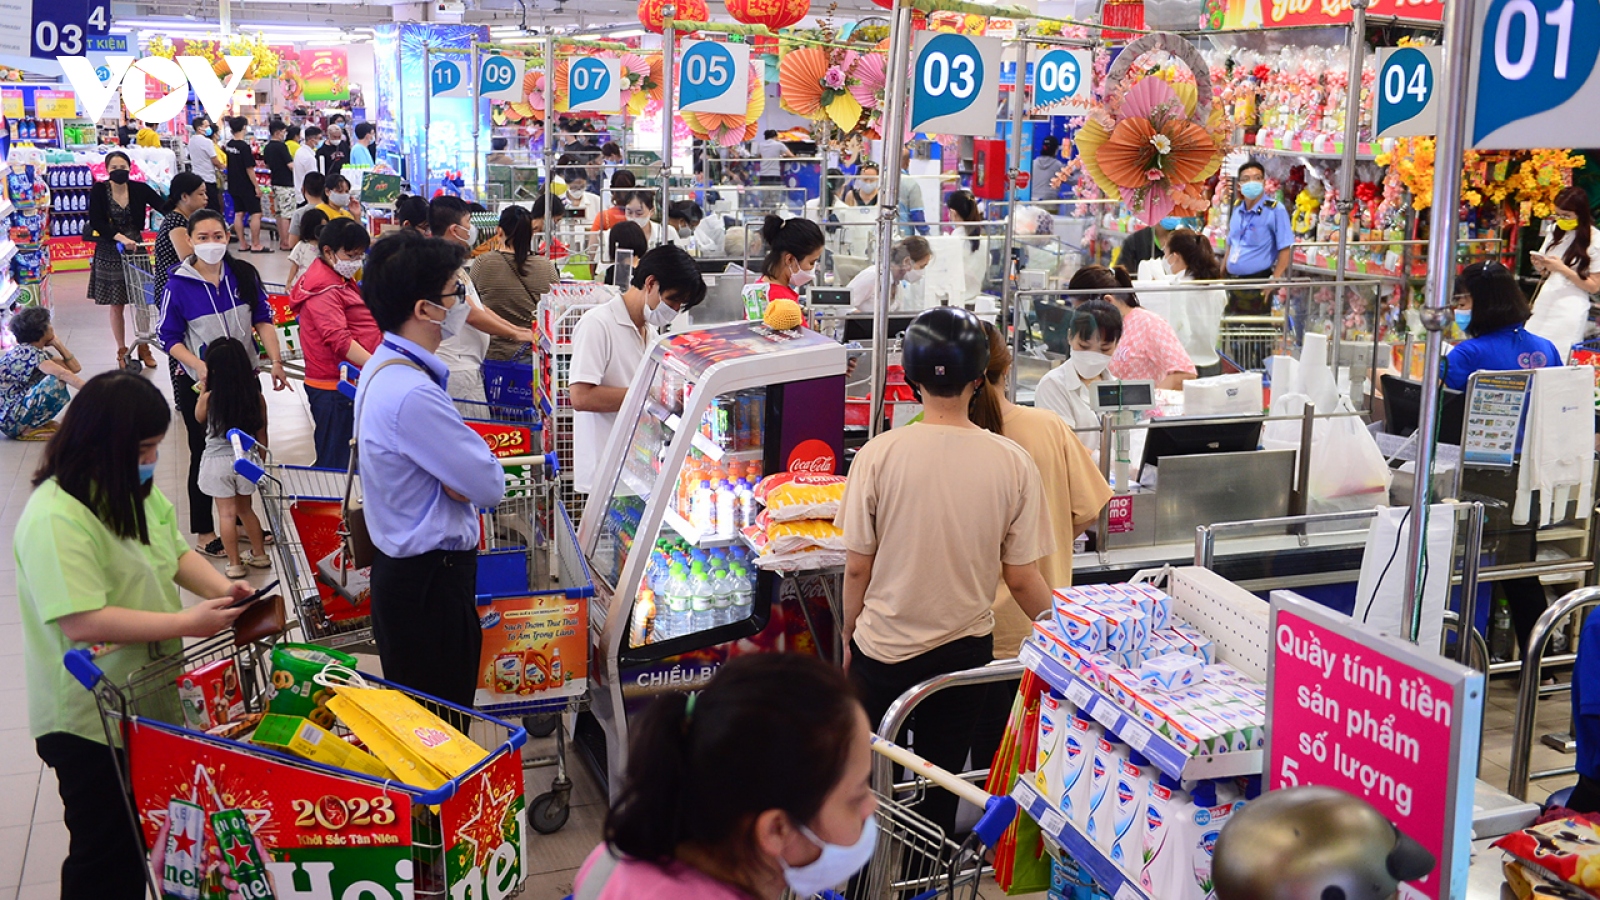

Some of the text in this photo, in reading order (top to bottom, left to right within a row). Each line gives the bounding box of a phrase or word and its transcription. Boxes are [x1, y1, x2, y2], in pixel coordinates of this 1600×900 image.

[35, 20, 83, 55] 03
[1494, 0, 1575, 80] 01
[434, 67, 452, 85] 11
[485, 63, 512, 86] 09
[573, 67, 607, 91] 07
[686, 54, 728, 87] 05
[922, 51, 975, 99] 03
[1040, 61, 1076, 92] 06
[1384, 63, 1427, 105] 04
[482, 430, 523, 451] 023
[636, 663, 696, 688] CHIỀU
[1276, 623, 1452, 727] Quầy tính tiền
[1297, 683, 1420, 764] sản phẩm
[1279, 755, 1300, 790] 5
[1298, 730, 1413, 817] số lượng
[291, 794, 396, 830] 2023
[297, 832, 400, 846] Khởi Sắc Tân Niên
